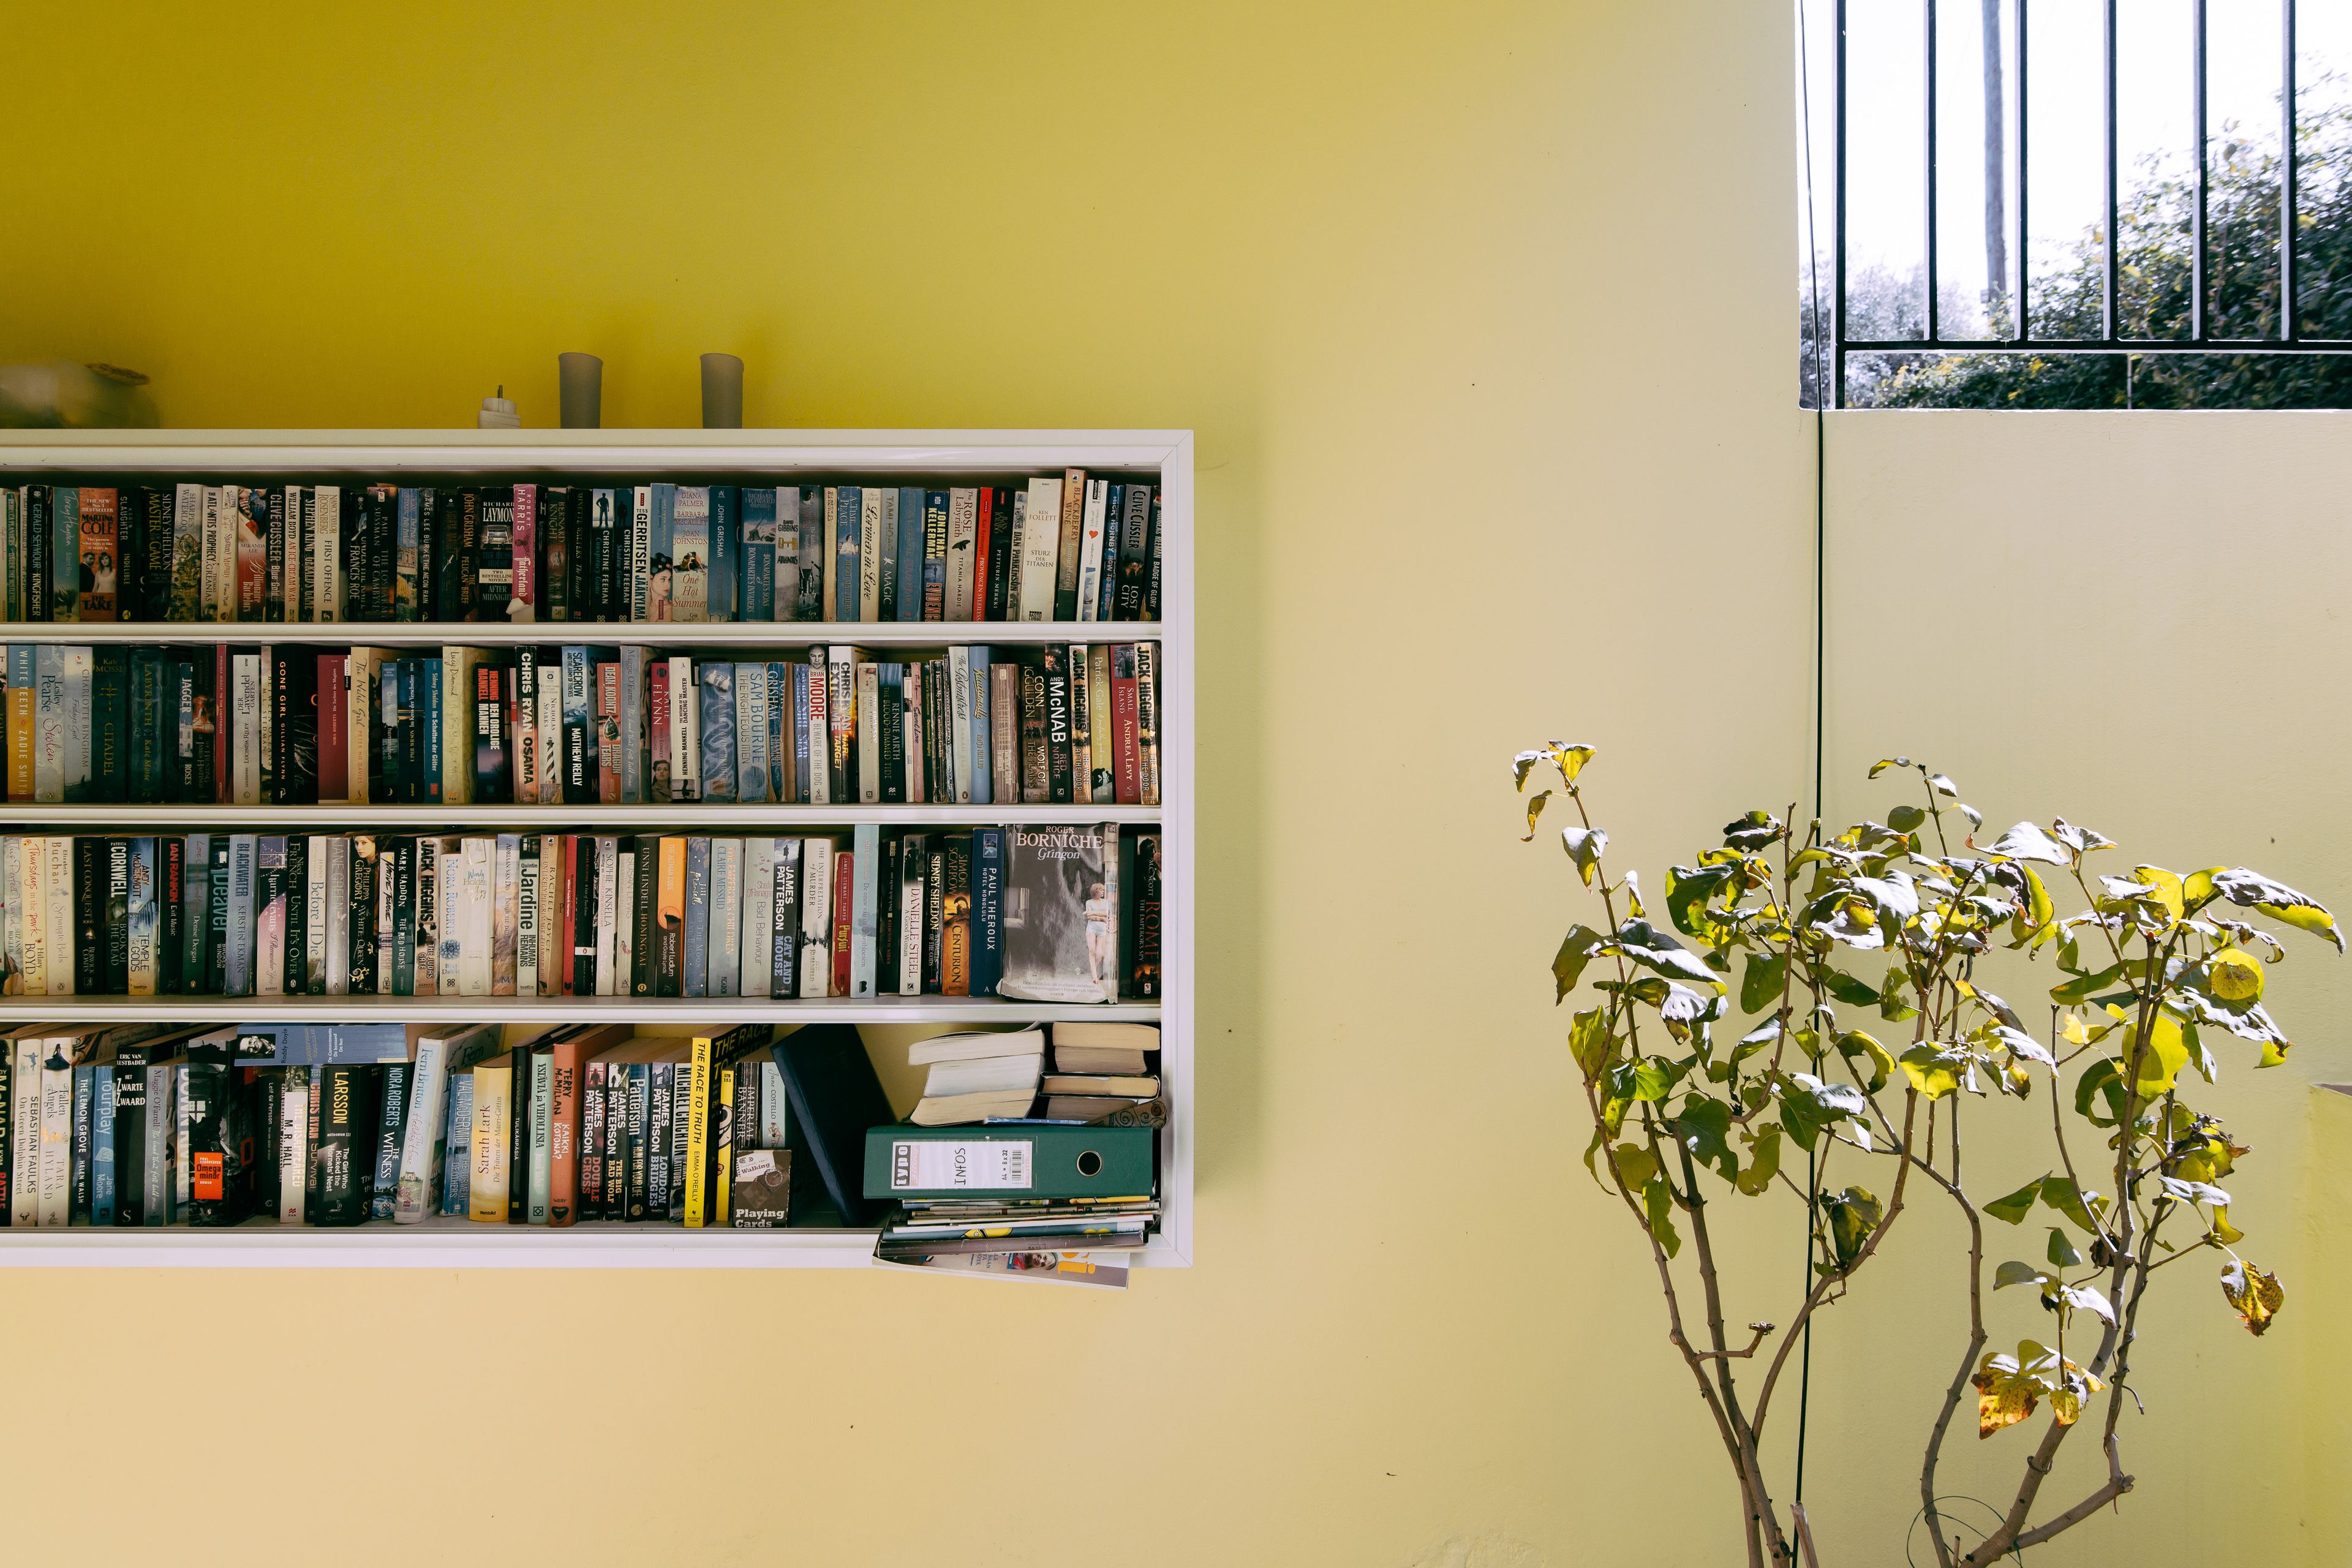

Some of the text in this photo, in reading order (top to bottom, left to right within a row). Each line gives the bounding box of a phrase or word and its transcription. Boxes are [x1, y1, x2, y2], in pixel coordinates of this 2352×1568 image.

[59, 491, 79, 548] Torey Hayden
[81, 522, 114, 535] COLE
[162, 493, 172, 571] SIDNEY SHELDON
[181, 489, 189, 532] WATERLOO
[207, 497, 217, 528] ATLANTIS
[270, 494, 282, 562] CLIVE CUSSLER
[517, 489, 526, 532] HARRIS
[925, 508, 937, 560] KELLERMAN
[936, 510, 946, 558] JONATHAN
[954, 496, 964, 538] Labyrinth
[1064, 502, 1072, 526] WINE
[1071, 487, 1081, 543] BLACKBERRY
[32, 503, 42, 616] GERALD SEYMOUR KINGFISHER
[1108, 519, 1117, 554] HORNBY
[323, 540, 333, 603] FIRST OFFENCE
[350, 545, 360, 601] FRANCIS ROE
[634, 514, 649, 620] GERRITSEN JÄÄKYLMÄ
[883, 571, 892, 606] MAGIC
[83, 601, 113, 611] TAKE
[243, 581, 253, 612] Bachelors
[41, 674, 56, 712] Pearse
[51, 681, 63, 706] Lesley
[181, 677, 192, 714] JAGGER
[430, 673, 439, 689] Sidney
[573, 652, 584, 697] SCARECROW
[1095, 656, 1104, 710] Patrick Gale
[1137, 646, 1155, 730] JACK HIGGINS
[19, 650, 28, 795] WHITE TEETH ZADIE SMITH
[478, 703, 489, 735] MANNEN
[489, 703, 500, 717] DEN
[521, 652, 533, 785] CHRIS RYAN OSAMA
[653, 684, 663, 725] FLYNN
[750, 673, 765, 764] SAM BOURNE
[810, 677, 825, 721] MOORE
[1049, 681, 1066, 743] McNAB
[571, 728, 582, 786] MATTHEW REILLY
[813, 723, 821, 747] BEWARE
[1123, 718, 1134, 781] ANDREA LEVY
[1015, 832, 1104, 849] BORNICHE
[1036, 847, 1080, 861] Gringon
[110, 846, 127, 898] CORNWELL
[235, 843, 251, 898] BLACKWATER
[288, 842, 301, 889] FRENCH
[354, 859, 364, 901] GREGORY
[362, 867, 372, 901] PHILIPPA
[640, 847, 650, 910] UNNI LINDELL
[715, 846, 727, 910] CLAIRE MESSUD
[311, 881, 325, 920] Before
[519, 868, 538, 930] Jardine
[775, 865, 785, 930] PATTERSON
[986, 867, 997, 951] PAUL THEROUX
[137, 933, 149, 972] TEMPLE
[191, 915, 201, 964] Denise Deegan
[289, 894, 301, 975] UNTIL IT'S OVER
[519, 934, 529, 967] REMAINS
[527, 934, 537, 967] INHUMAN
[668, 932, 677, 954] Robert
[754, 922, 765, 966] Behaviour
[908, 888, 921, 978] DANIELLE STEEL
[951, 924, 963, 984] CENTURION
[24, 943, 36, 975] BOYD
[130, 946, 140, 973] GODS
[333, 1071, 349, 1125] LARSSON
[414, 1047, 434, 1109] Fern Britton
[552, 1068, 564, 1115] McMILLAN
[693, 1042, 706, 1144] THE RACE TO TRUTH
[78, 1094, 88, 1153] LEMON GROVE
[385, 1089, 402, 1126] ROBERTS
[628, 1078, 647, 1136] Patterson
[736, 1086, 746, 1140] BANNER
[745, 1087, 756, 1140] IMPERIAL
[27, 1096, 39, 1194] SEBASTIAN FAULKS
[380, 1131, 396, 1179] WITNESS
[478, 1104, 491, 1175] Sarah Lark
[195, 1163, 222, 1173] Omega
[692, 1172, 700, 1202] O'REILLY
[741, 1163, 771, 1174] Walking
[896, 1145, 909, 1186] typo
[954, 1147, 967, 1185] INFOS
[736, 1208, 785, 1219] Playing
